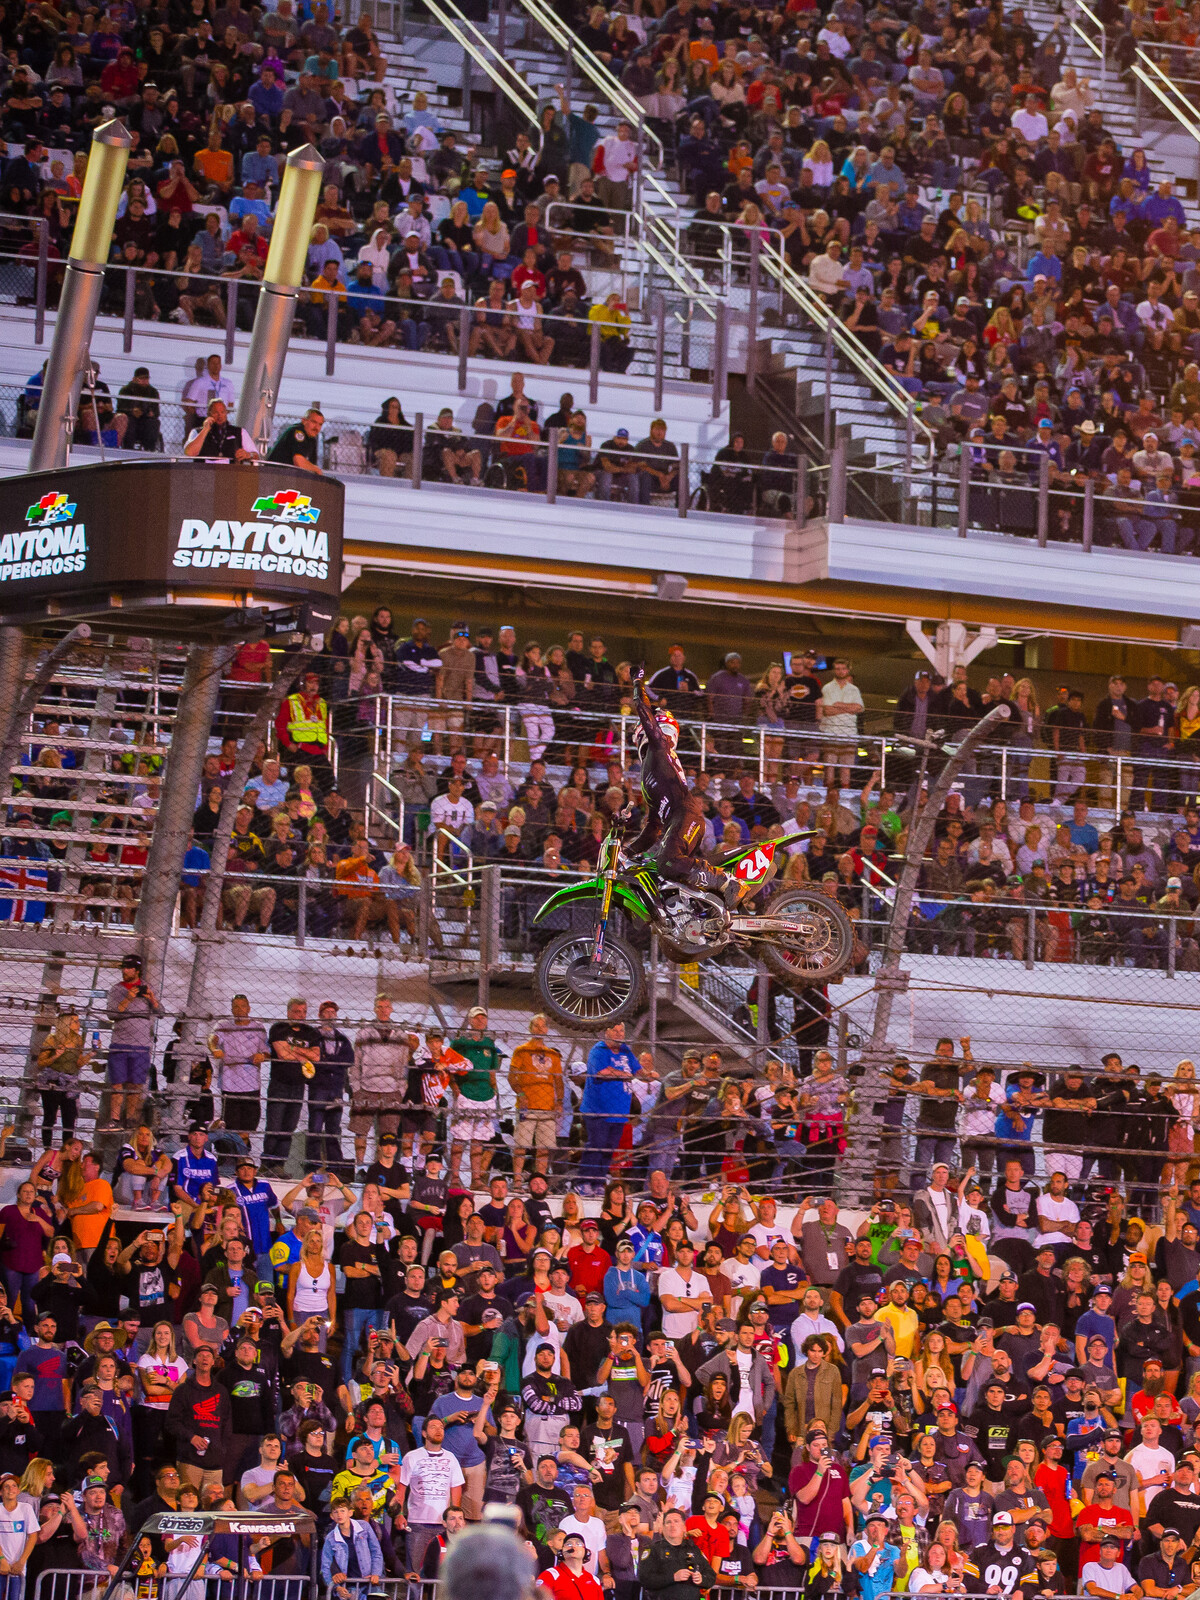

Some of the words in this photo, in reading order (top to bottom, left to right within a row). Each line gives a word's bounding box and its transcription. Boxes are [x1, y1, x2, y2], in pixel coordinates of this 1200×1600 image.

[0, 523, 87, 562] AYTONA
[178, 519, 329, 561] DAYTONA
[172, 550, 329, 580] SUPERCROSS
[739, 849, 770, 880] 24
[229, 1521, 296, 1534] Kawasaki
[984, 1564, 1019, 1595] 99
